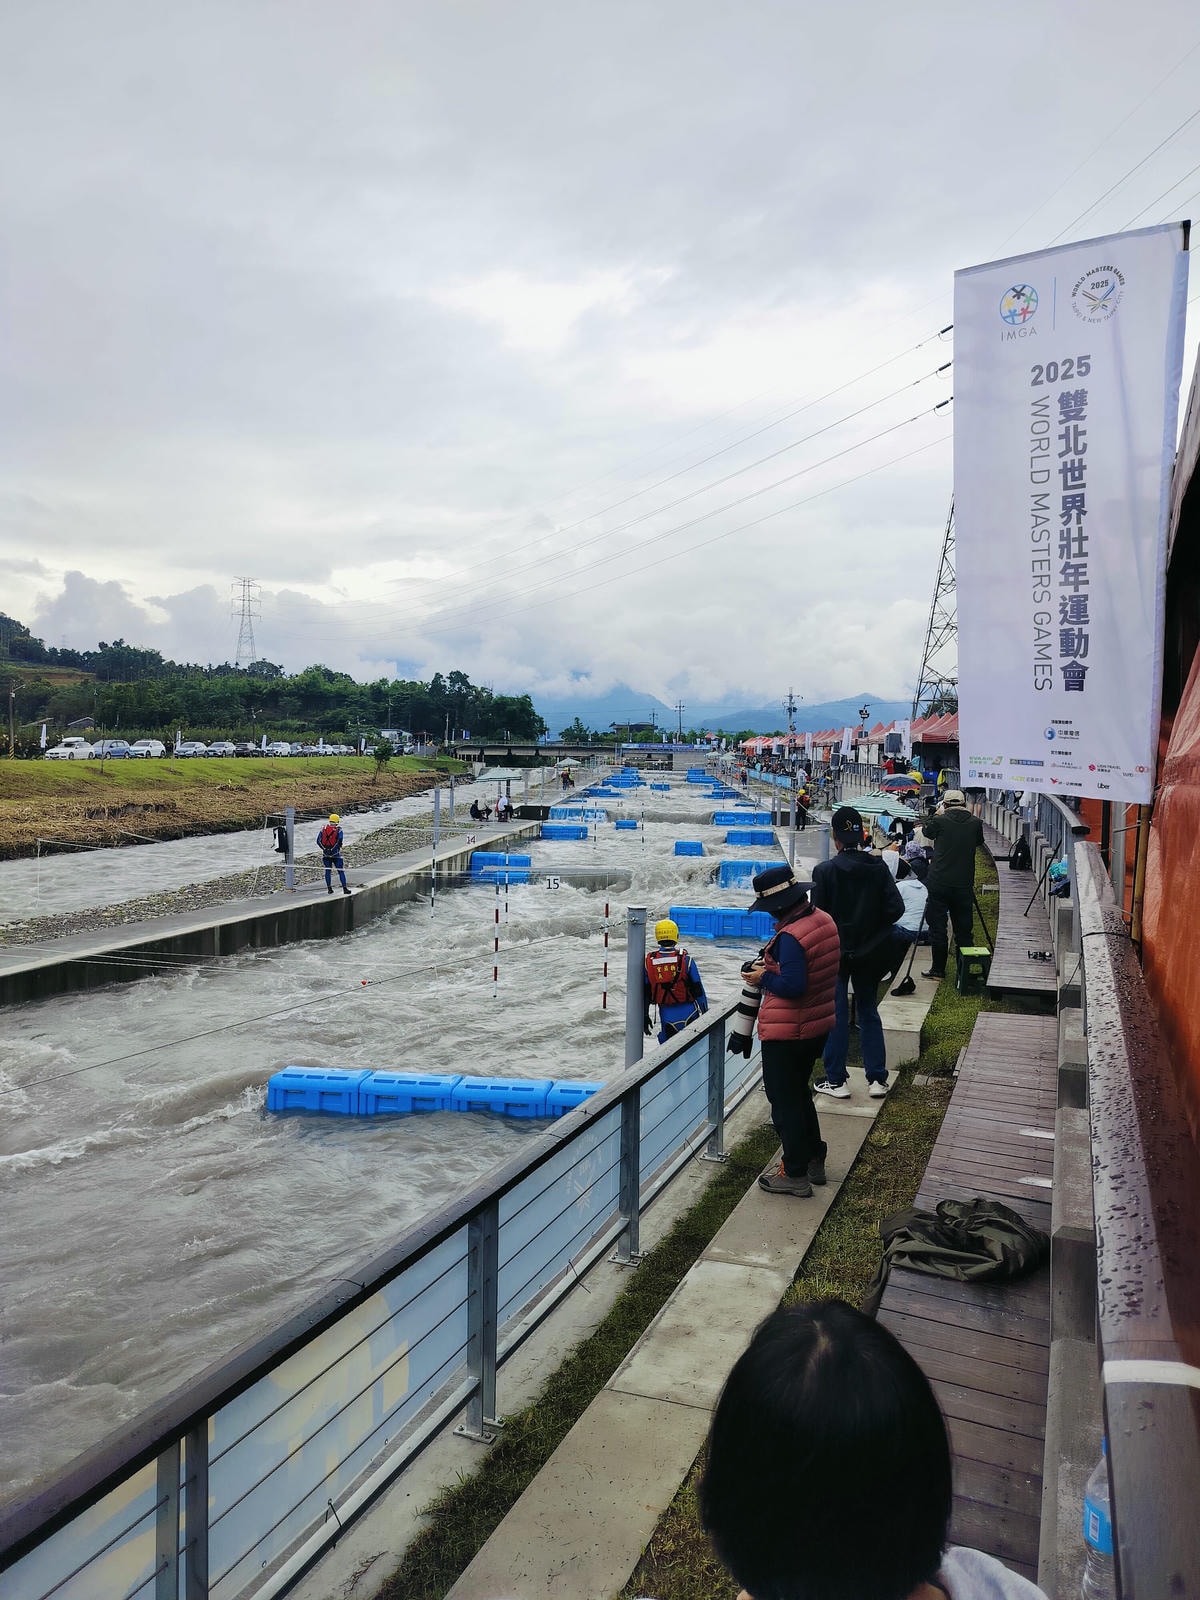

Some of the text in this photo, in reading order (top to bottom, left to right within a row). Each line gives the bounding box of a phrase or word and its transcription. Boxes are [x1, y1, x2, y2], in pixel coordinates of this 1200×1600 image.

[1072, 265, 1126, 298] WORLD MASTERS GAMES
[1090, 279, 1109, 290] 2025
[1088, 316, 1102, 324] NEW
[1001, 326, 1037, 342] IMGA
[1030, 354, 1091, 387] 2025
[1030, 395, 1053, 691] WORLD MASTERS GAMES
[1057, 388, 1090, 692] 雙北世界壯年運動會
[1097, 782, 1111, 790] Uber
[466, 835, 476, 845] 14
[545, 877, 560, 890] 15
